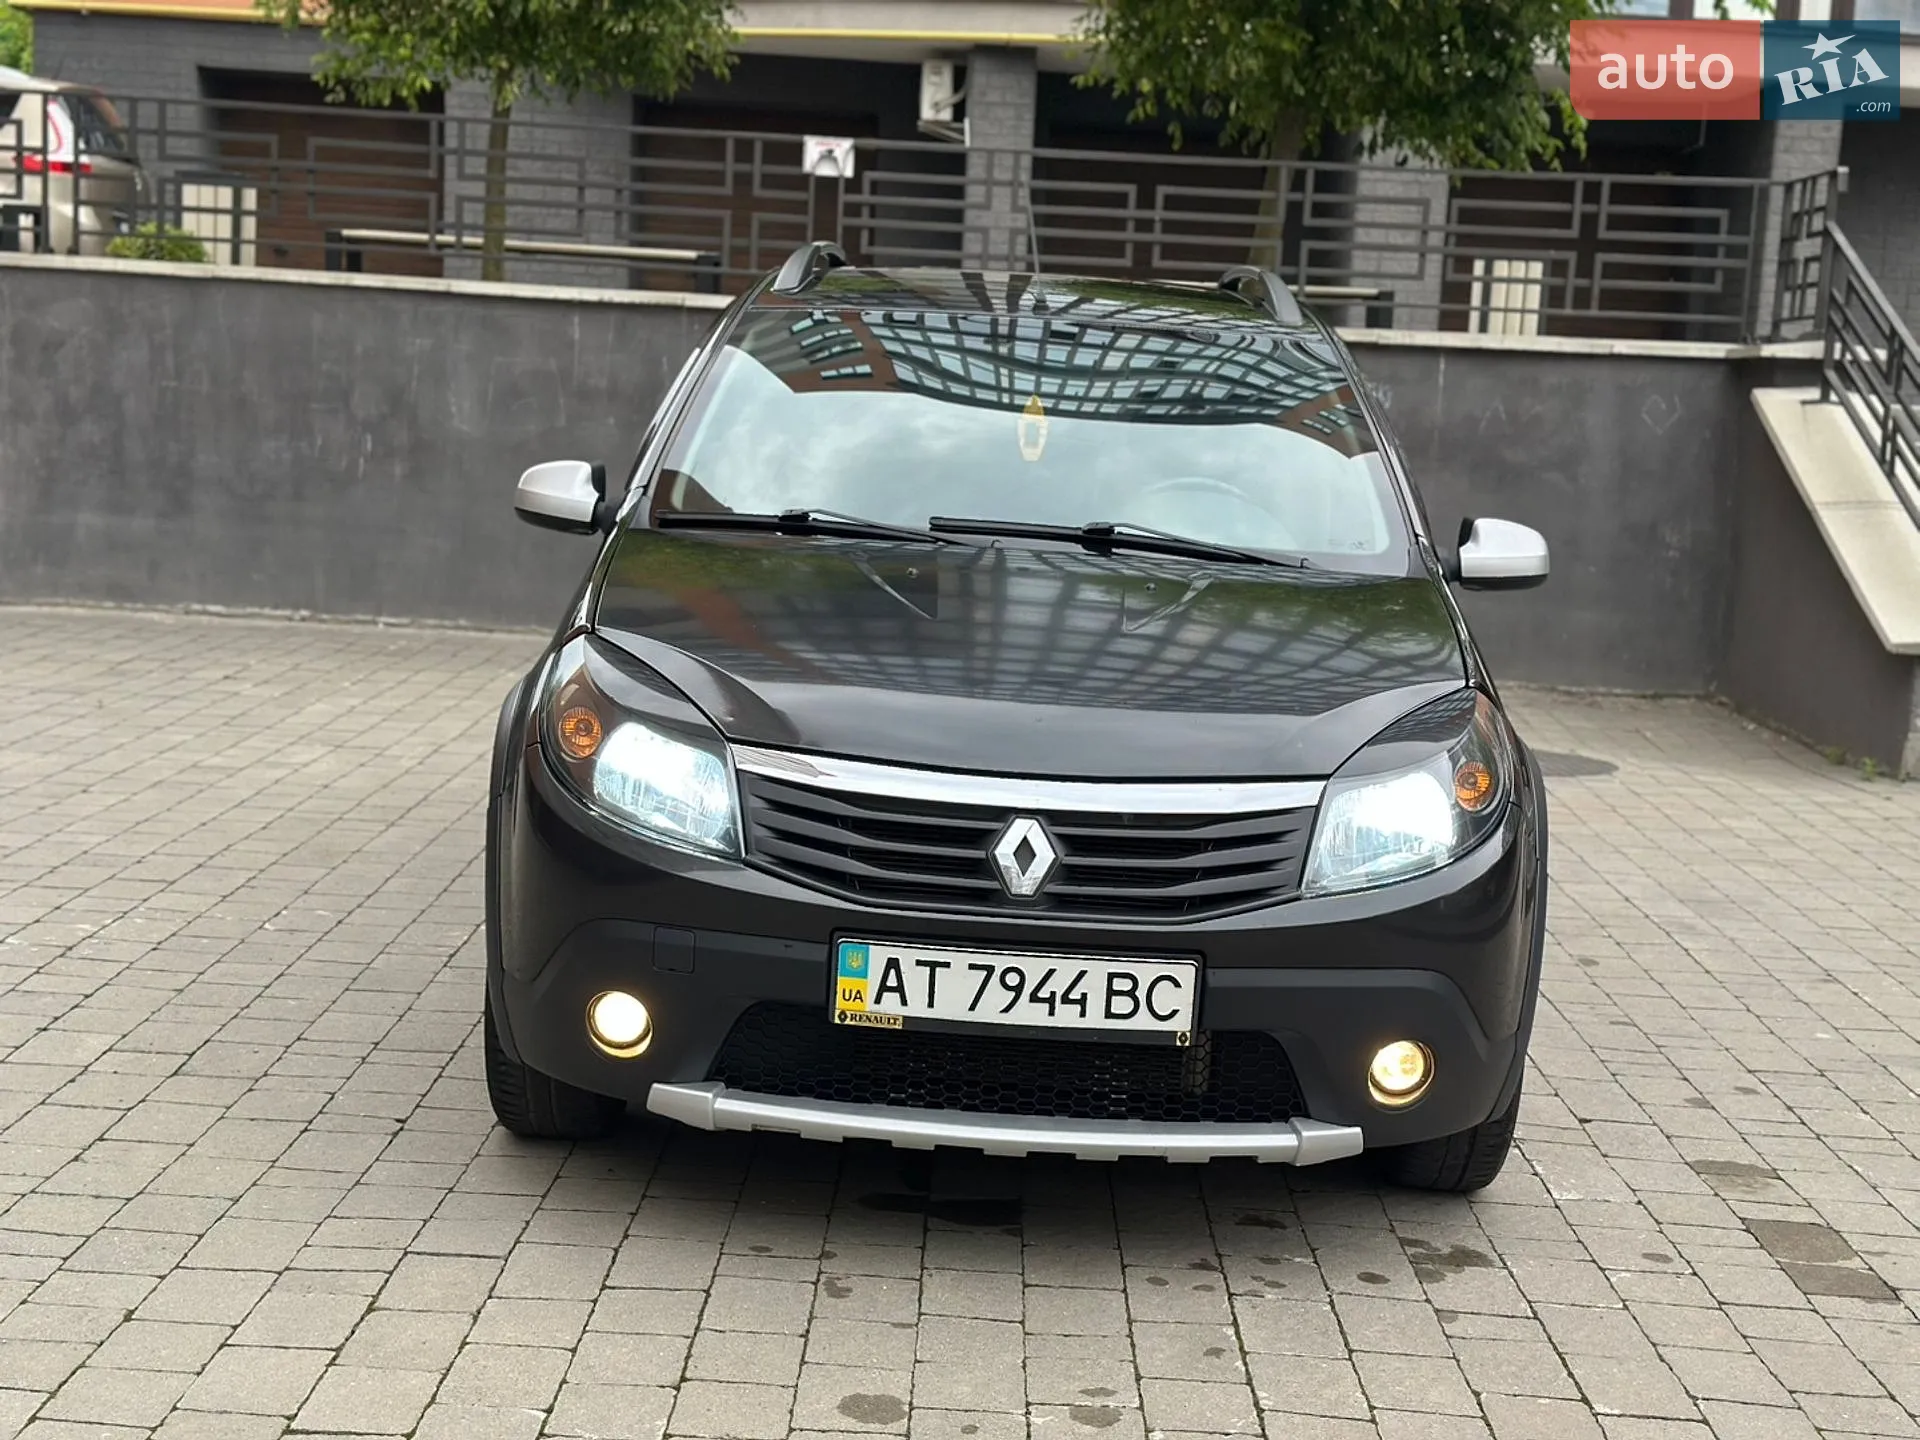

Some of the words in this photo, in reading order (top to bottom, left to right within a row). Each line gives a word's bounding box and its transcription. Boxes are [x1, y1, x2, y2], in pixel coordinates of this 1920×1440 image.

[842, 988, 864, 1003] UA
[873, 956, 951, 1009] AT
[967, 962, 1088, 1018] 7944
[1104, 971, 1182, 1023] BC
